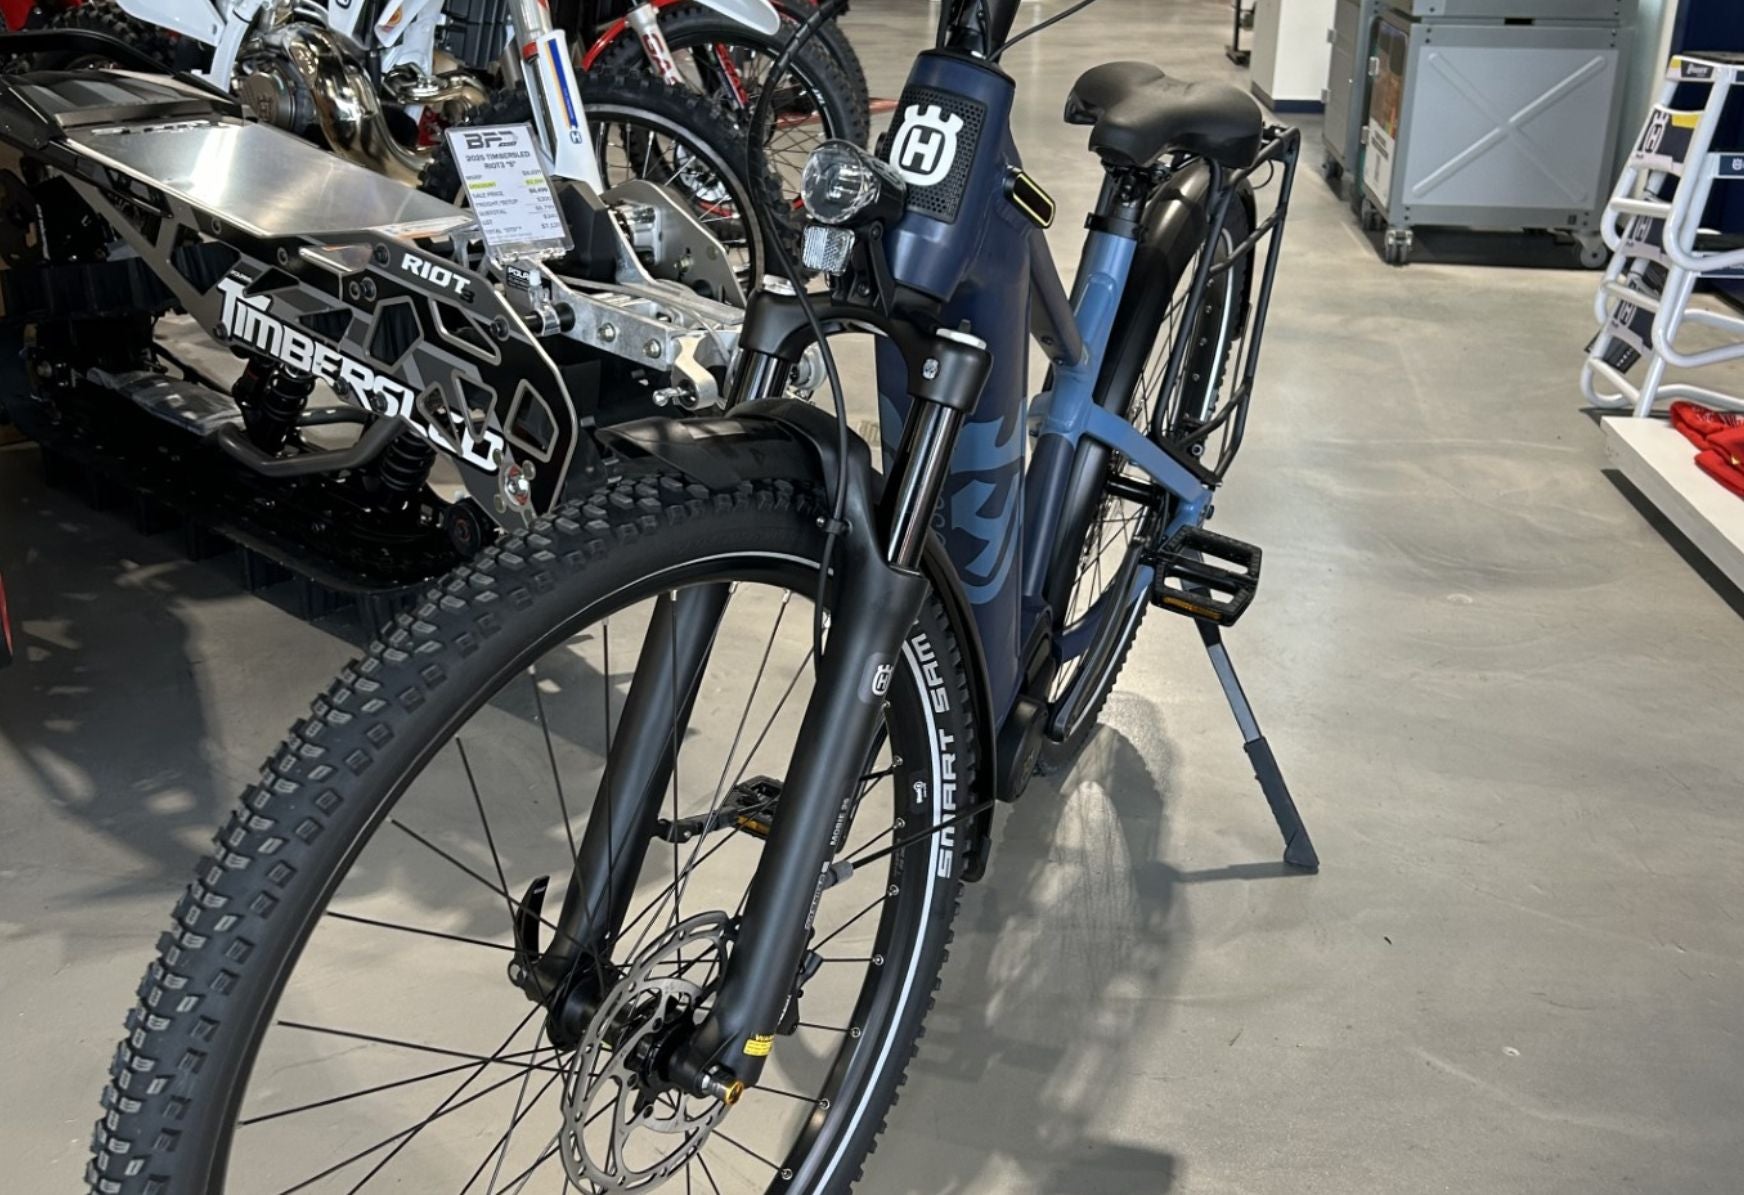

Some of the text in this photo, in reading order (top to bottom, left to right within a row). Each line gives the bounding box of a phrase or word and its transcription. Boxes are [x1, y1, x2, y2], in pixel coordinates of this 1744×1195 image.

[463, 130, 518, 149] BFD
[401, 253, 471, 294] RIOT
[911, 633, 957, 879] SMART SAM
